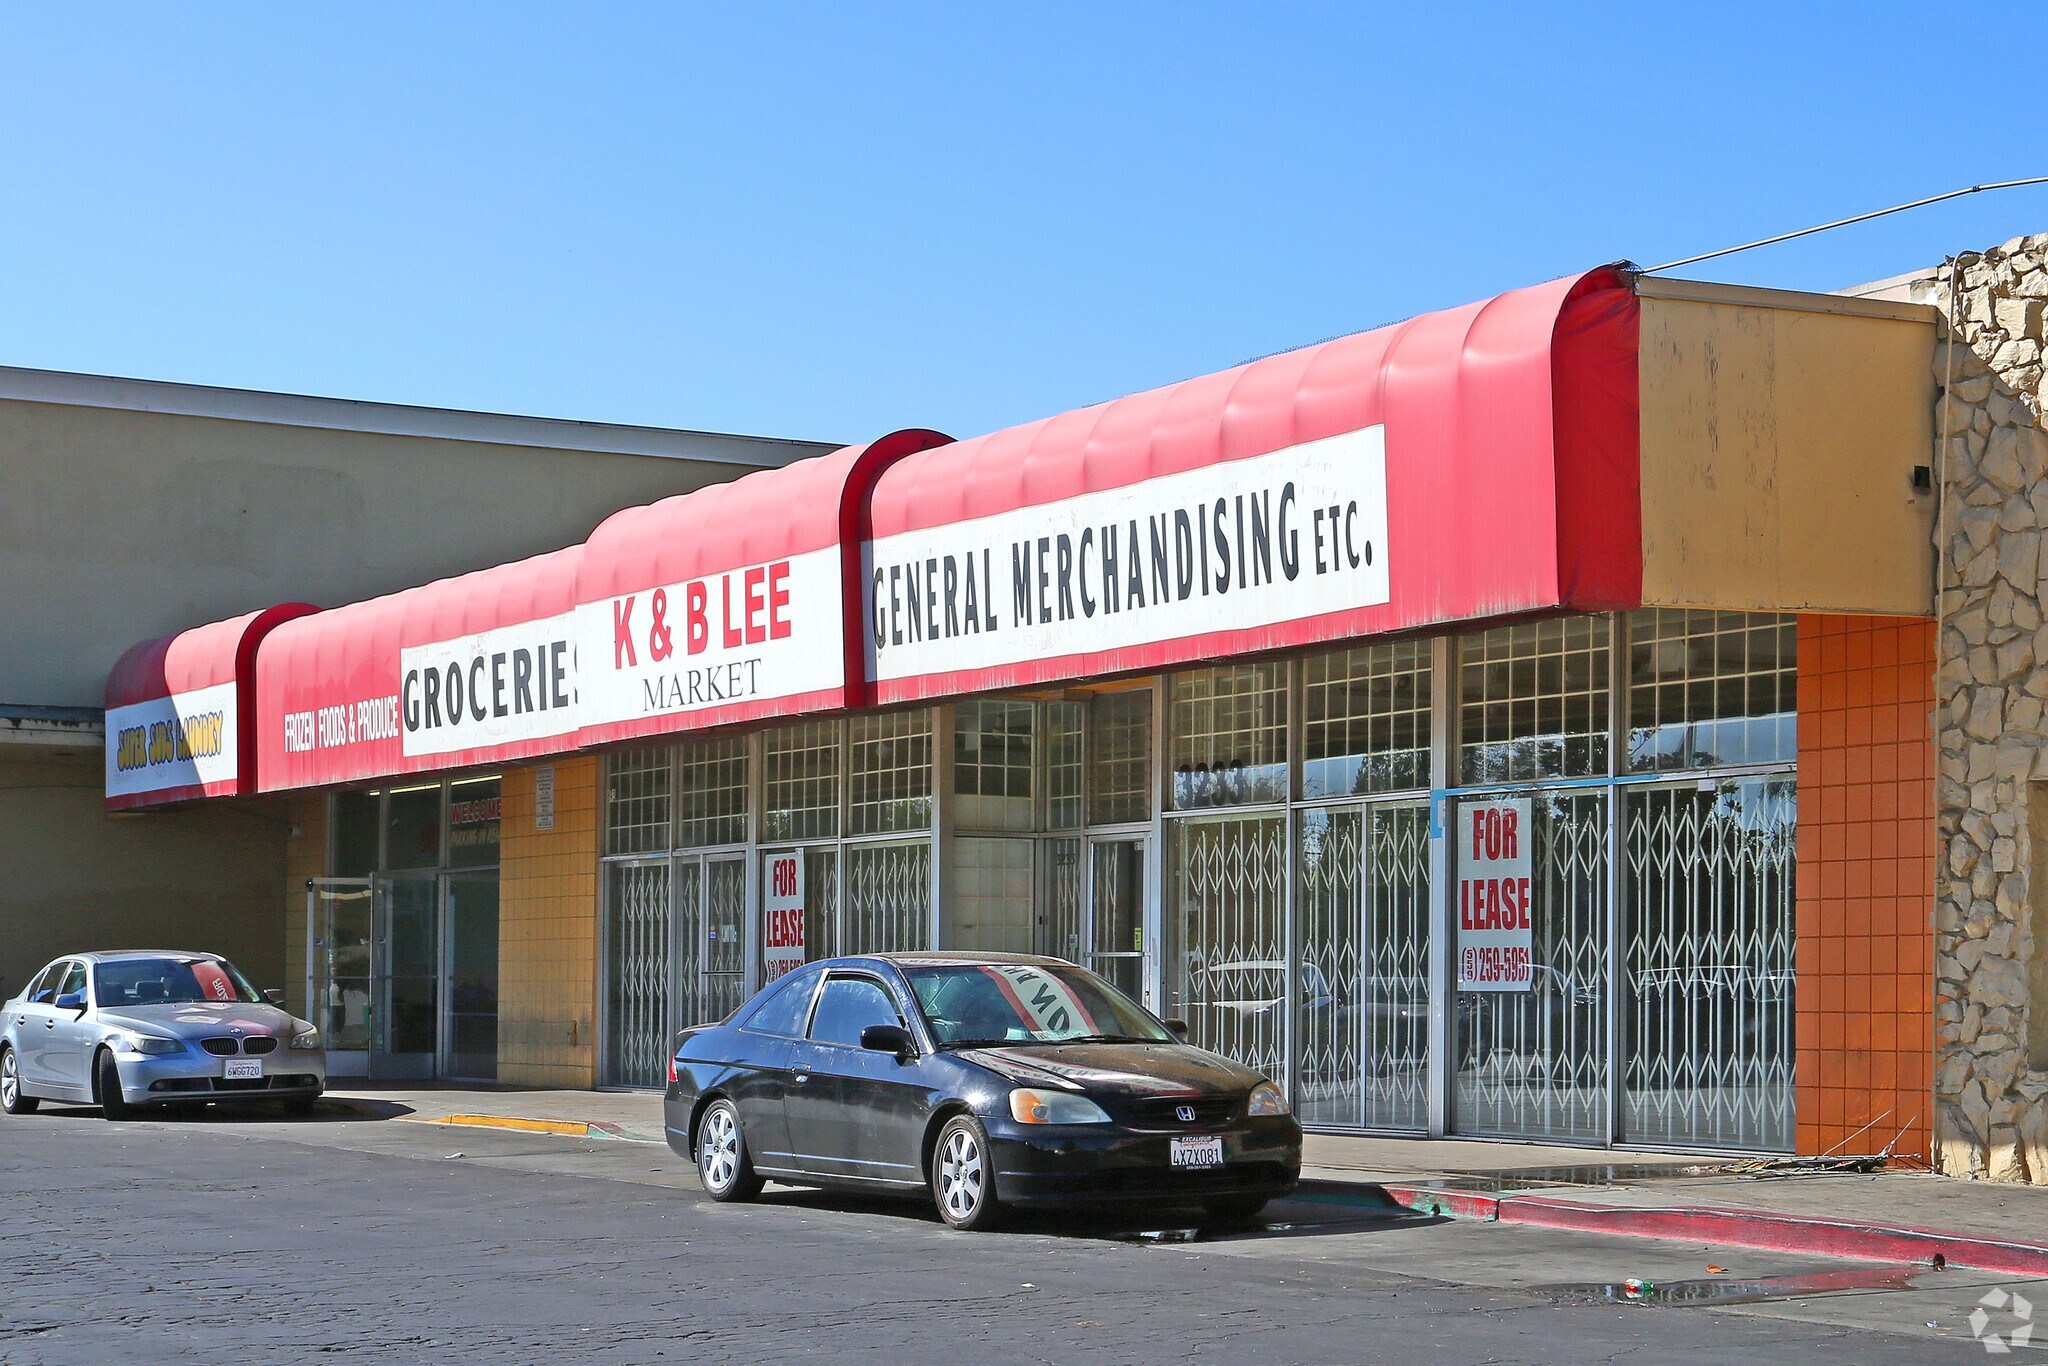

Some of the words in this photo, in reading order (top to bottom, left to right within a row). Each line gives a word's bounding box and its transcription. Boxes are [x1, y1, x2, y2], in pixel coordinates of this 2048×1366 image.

[872, 548, 998, 649] GENERAL
[1012, 481, 1300, 628] MERCHANDISING
[1313, 500, 1373, 575] ETC.
[613, 596, 638, 669] K
[650, 588, 673, 662] &
[686, 580, 709, 655] B
[722, 561, 792, 649] LEE
[641, 658, 762, 712] MARKET
[117, 724, 148, 772] SUPER
[148, 719, 175, 767] SUDS
[175, 710, 224, 763] LAUNDRY
[284, 711, 316, 753] FROZEN
[318, 704, 346, 749] FOODS
[348, 703, 356, 744] &
[357, 695, 399, 743] PRODUCE
[1176, 759, 1244, 810] 3233
[450, 797, 501, 825] WELCOME
[1472, 807, 1518, 861] FOR
[772, 858, 797, 898] FOR
[1461, 877, 1530, 931] LEASE
[766, 908, 804, 948] LEASE
[1479, 946, 1530, 982] 259-5951
[228, 1066, 260, 1076] 6WGG720
[1173, 1148, 1220, 1165] 4XZX081
